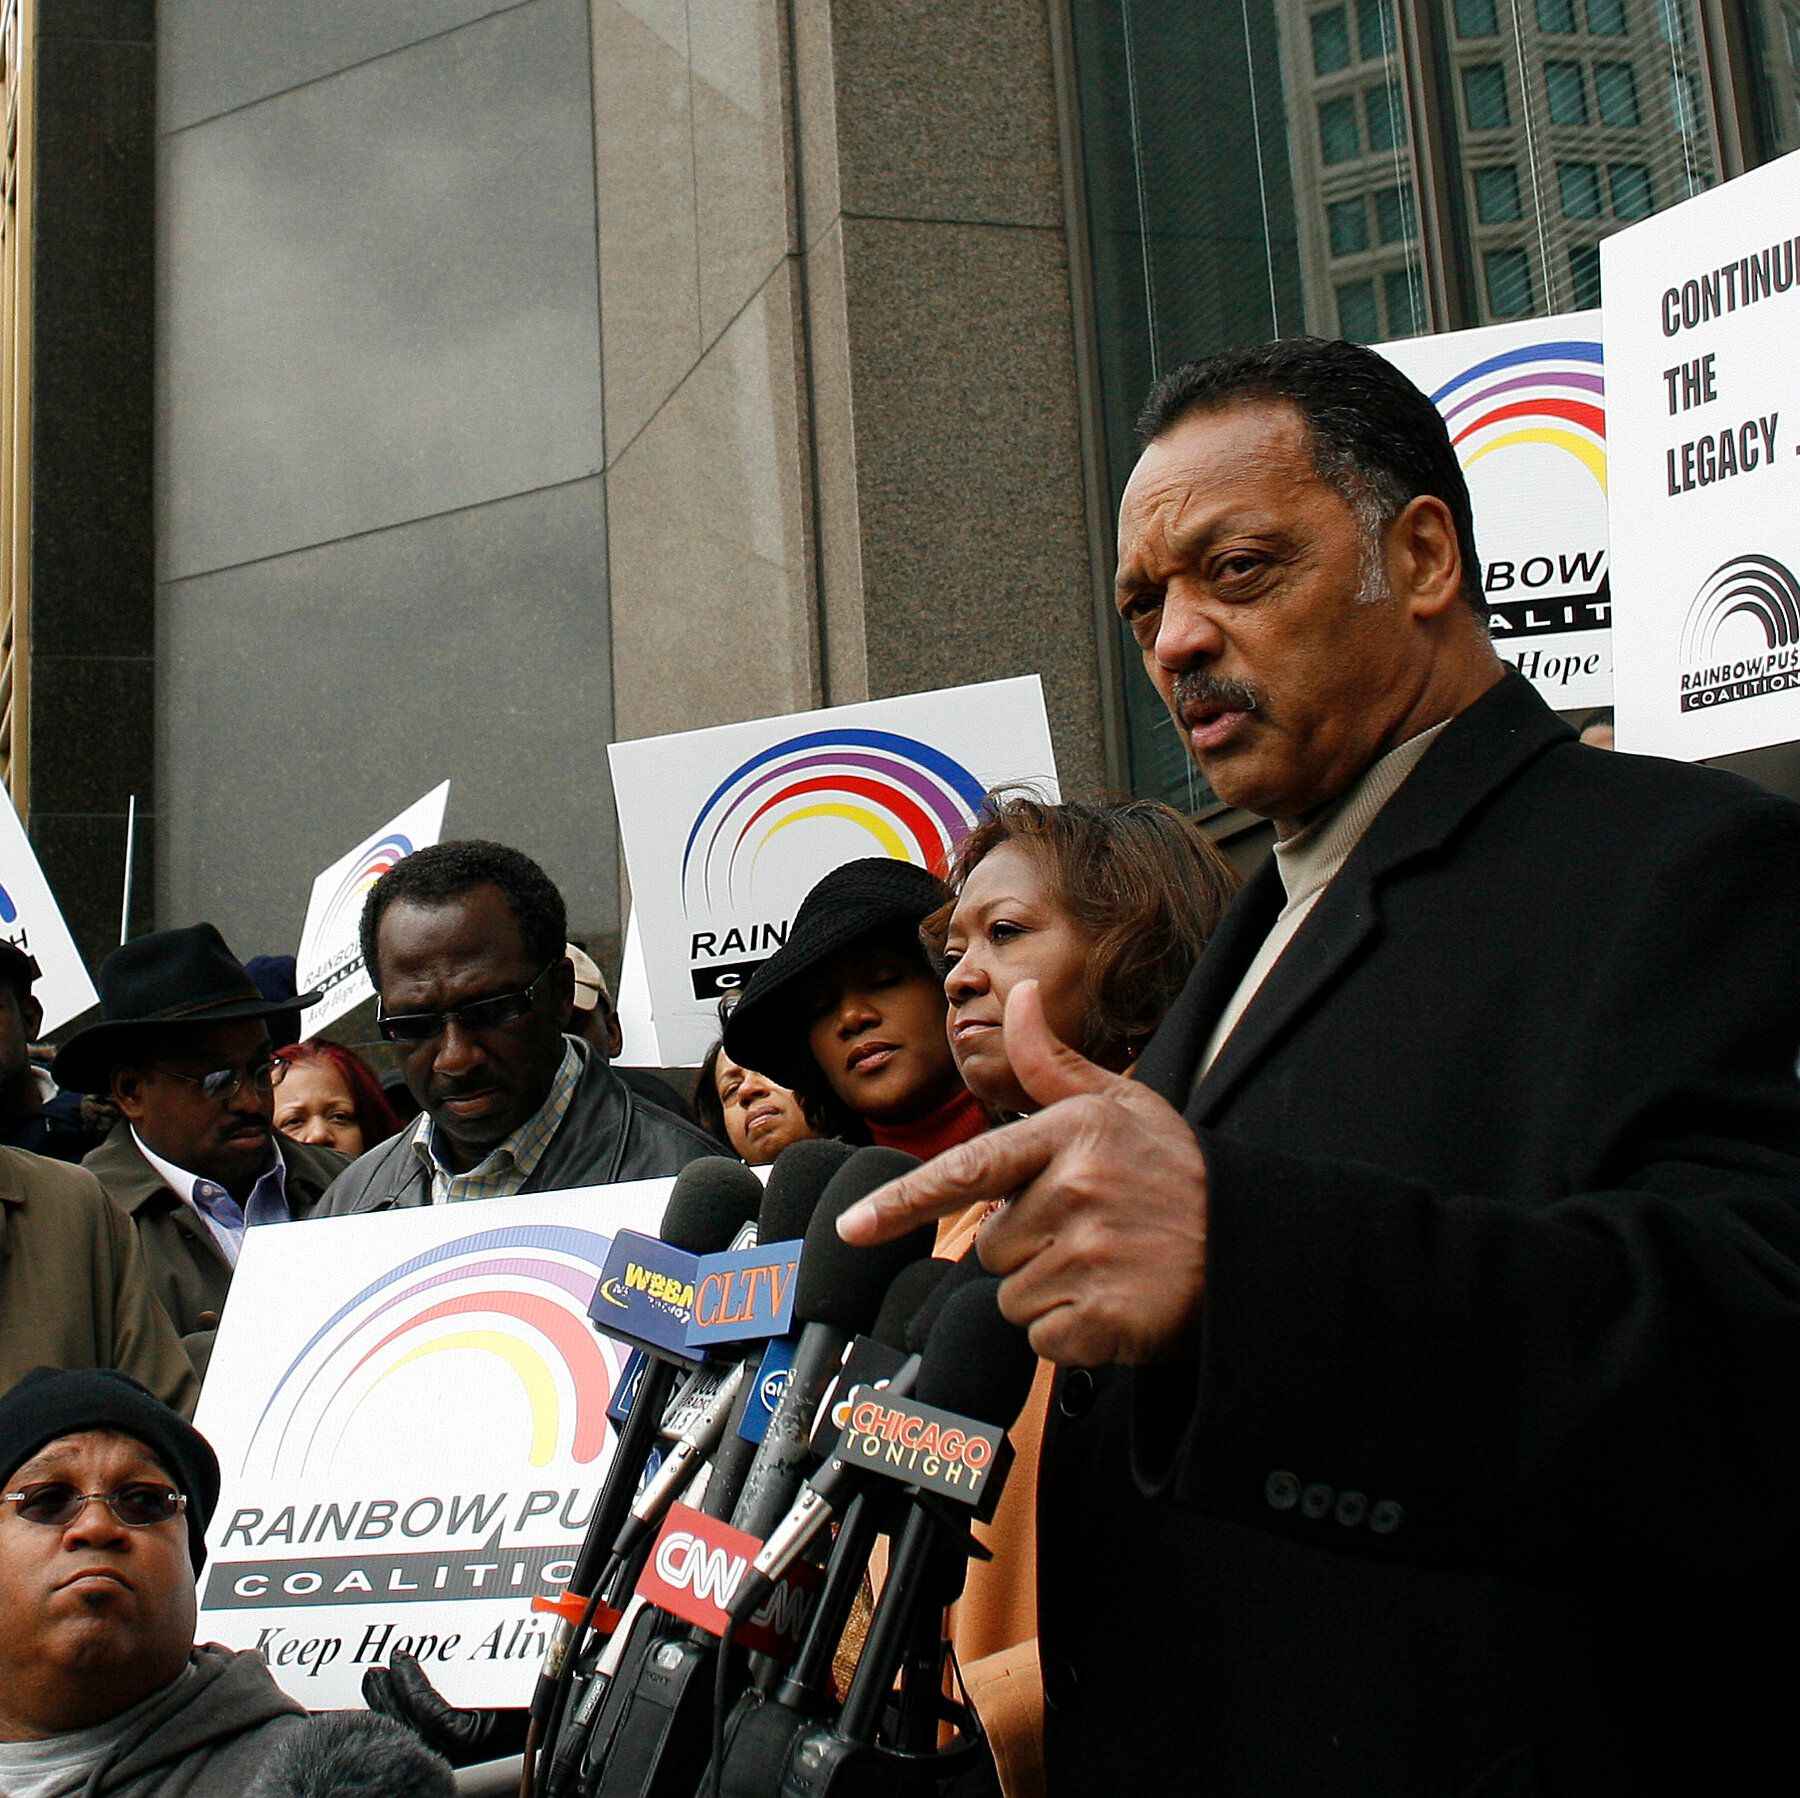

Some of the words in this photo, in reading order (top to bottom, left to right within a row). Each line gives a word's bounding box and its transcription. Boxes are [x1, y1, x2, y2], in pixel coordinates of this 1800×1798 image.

[1663, 352, 1717, 416] THE
[1666, 411, 1779, 497] LEGACY
[1517, 649, 1600, 686] Hope
[1681, 655, 1764, 692] RAINBOW
[693, 1262, 798, 1328] CLTV
[846, 1428, 983, 1490] TONIGHT
[852, 1402, 992, 1469] CHICAGO
[219, 1492, 509, 1548] RAINBOW
[233, 1559, 576, 1599] COALITIO
[655, 1531, 748, 1610] CNN
[254, 1627, 343, 1677] Keep
